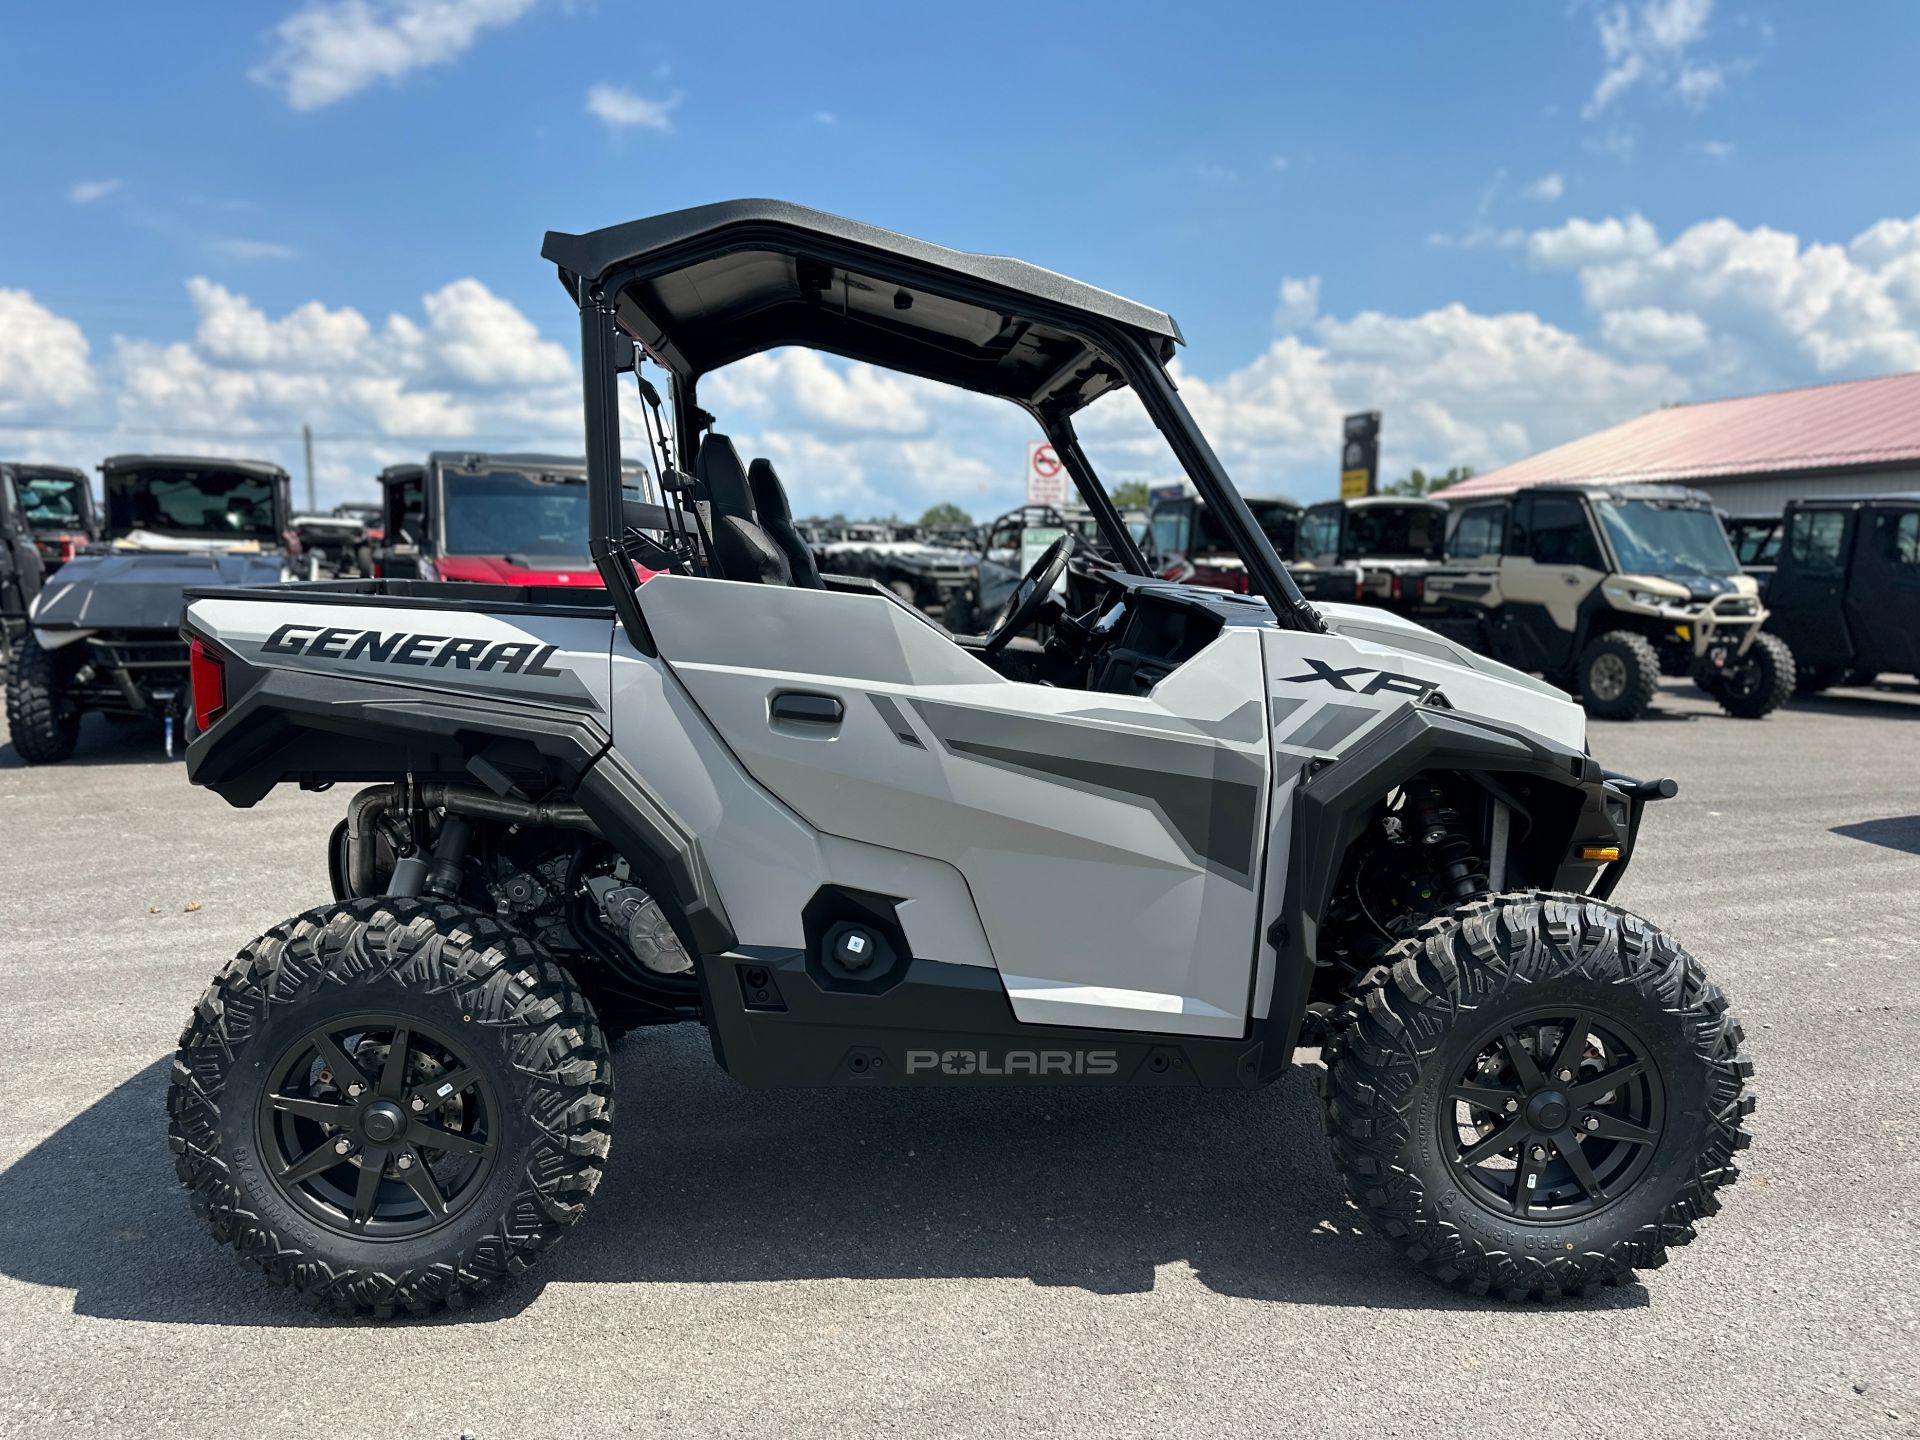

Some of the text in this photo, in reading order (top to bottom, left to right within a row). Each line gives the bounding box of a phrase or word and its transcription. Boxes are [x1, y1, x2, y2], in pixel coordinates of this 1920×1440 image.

[260, 623, 562, 678] GENERAL
[1277, 657, 1441, 698] XP
[906, 1050, 1119, 1075] POLARIS
[245, 1177, 320, 1249] CRAWLER
[1458, 1205, 1567, 1250] PRO ARMOR
